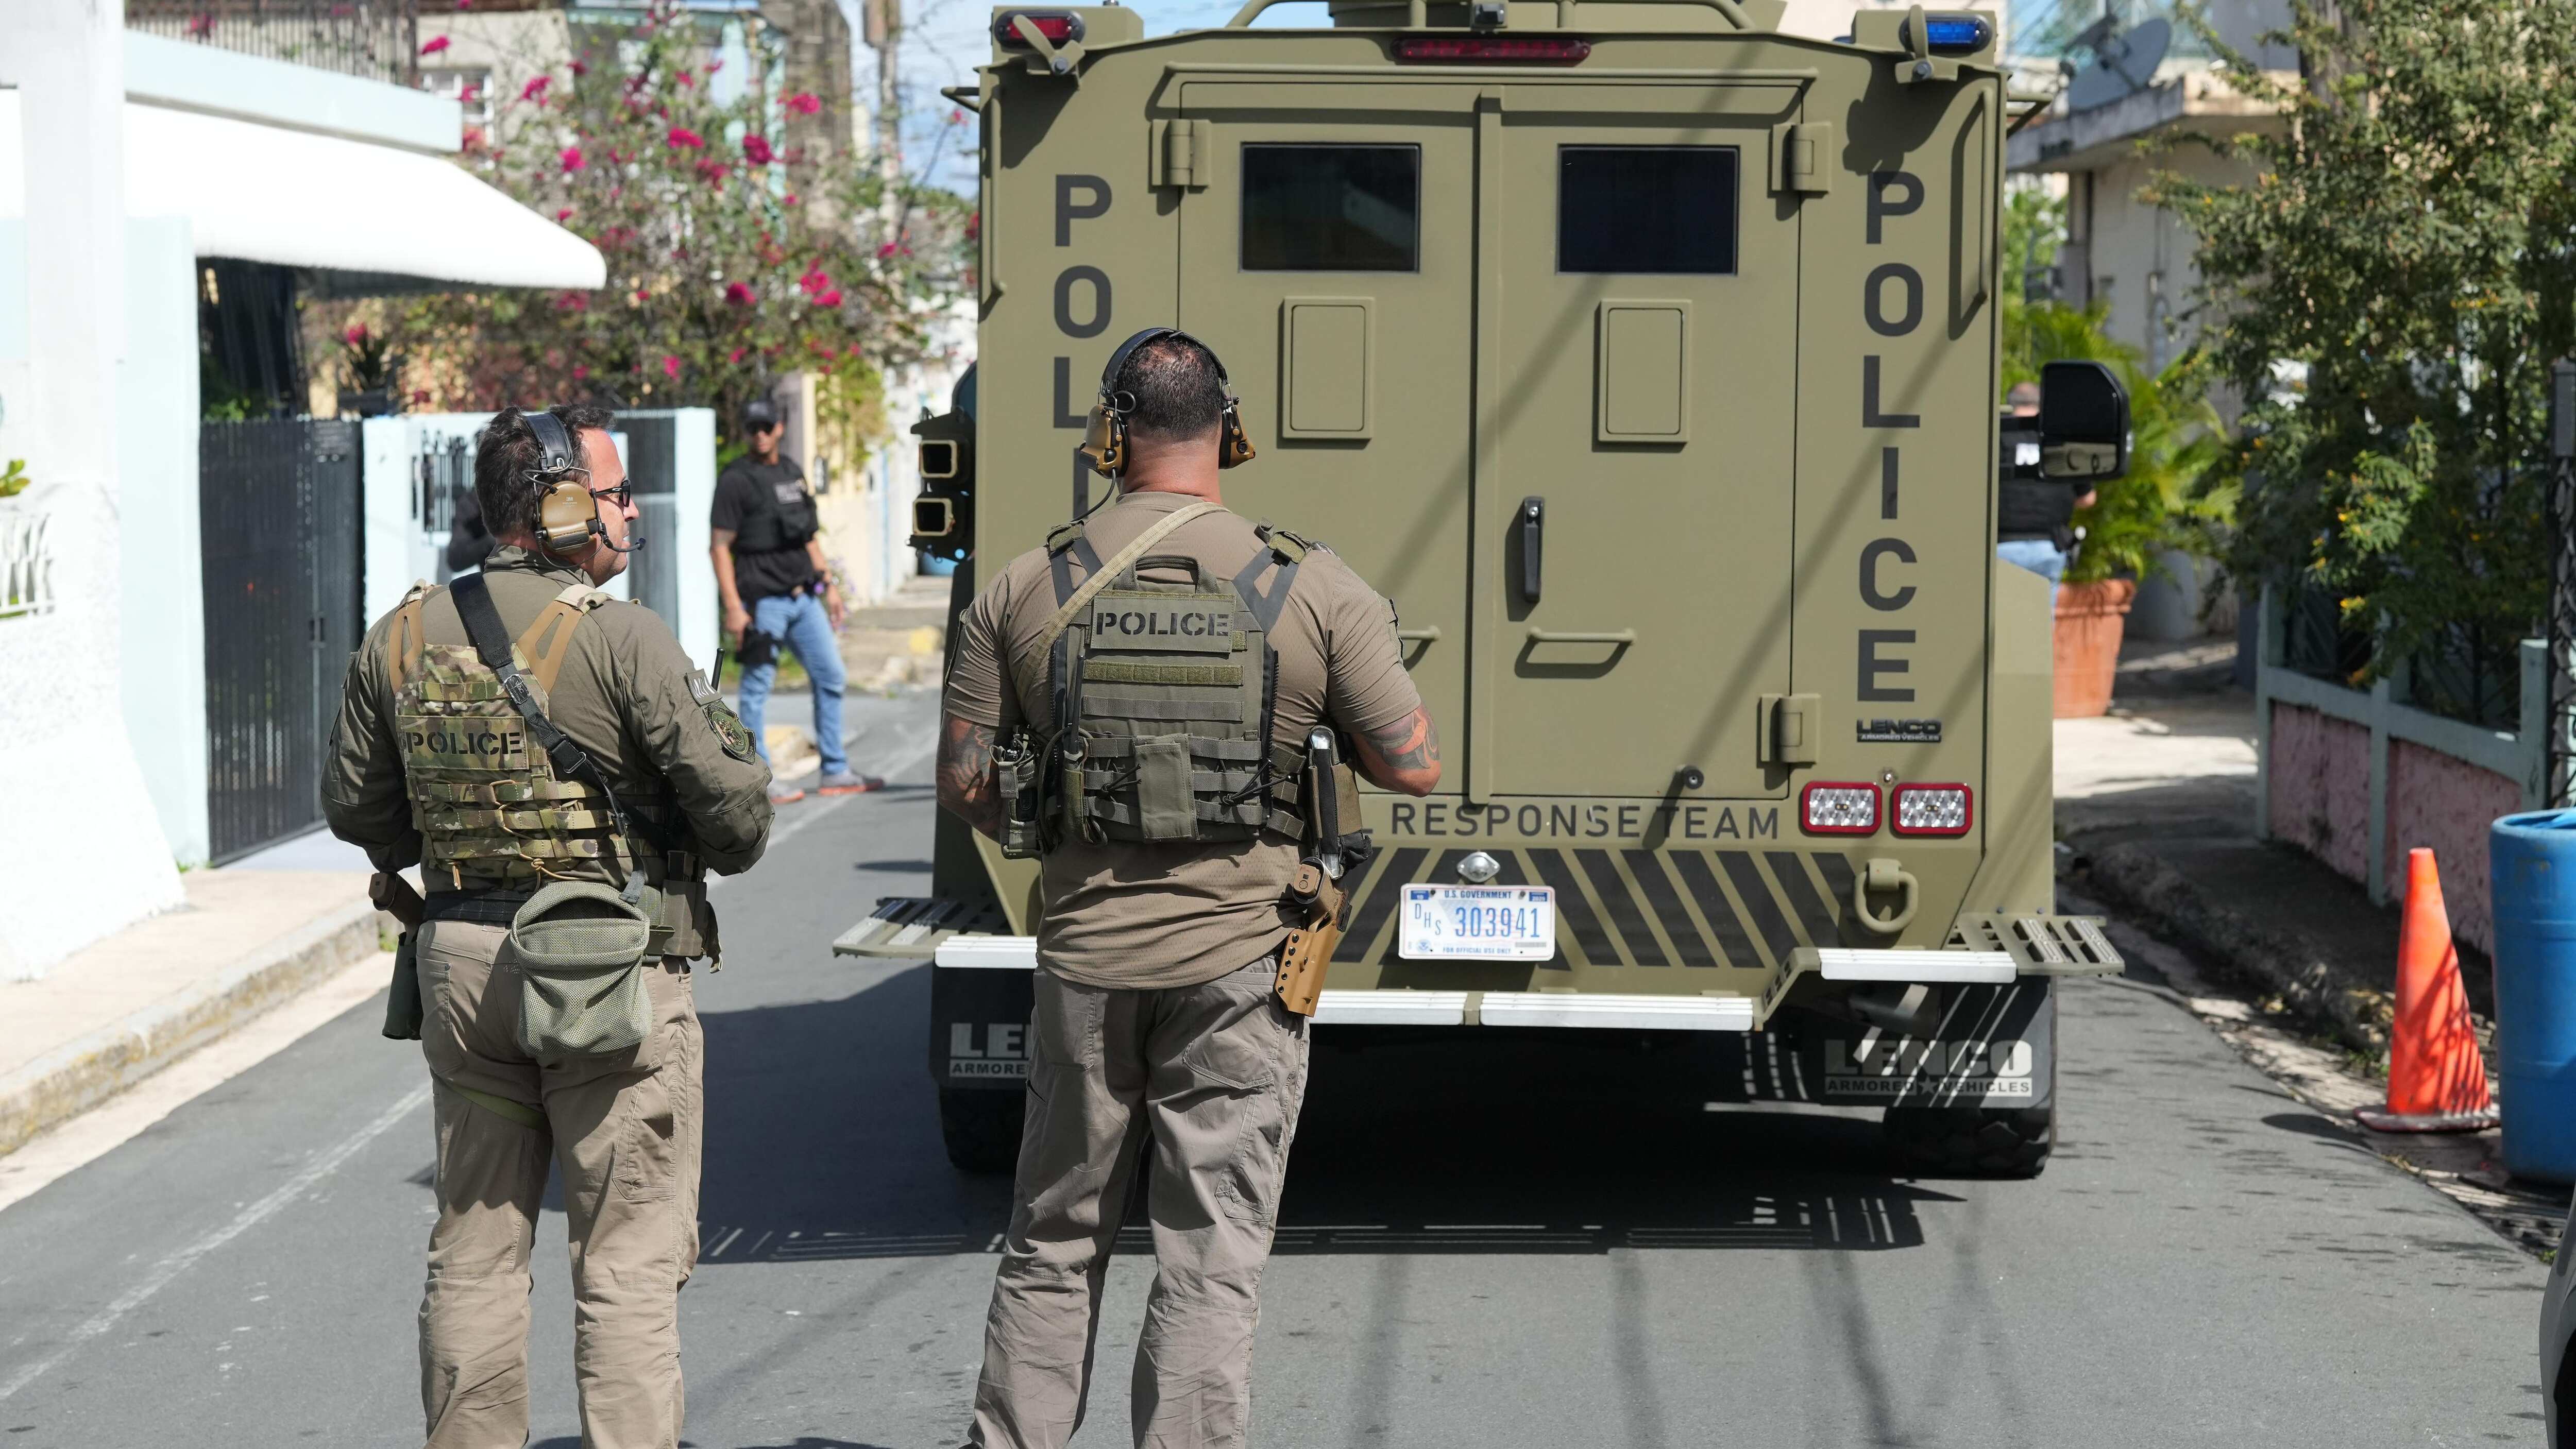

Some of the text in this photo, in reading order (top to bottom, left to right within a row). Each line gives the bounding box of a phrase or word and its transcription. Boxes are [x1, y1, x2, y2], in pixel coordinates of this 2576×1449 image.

[1053, 174, 1113, 521] POLI
[1857, 171, 1925, 702] POLICE
[1096, 611, 1230, 637] POLICE
[1857, 720, 1941, 734] LENCO
[405, 732, 522, 755] POLICE
[1391, 803, 1779, 840] RESPONSE TEAM
[1445, 890, 1512, 899] U.S. GOVERNMENT
[1455, 907, 1540, 938] 303941
[952, 1063, 1026, 1075] ARMORE
[1824, 1039, 2032, 1077] LENCO
[1827, 1080, 2029, 1093] ARMORED VEHICLES
